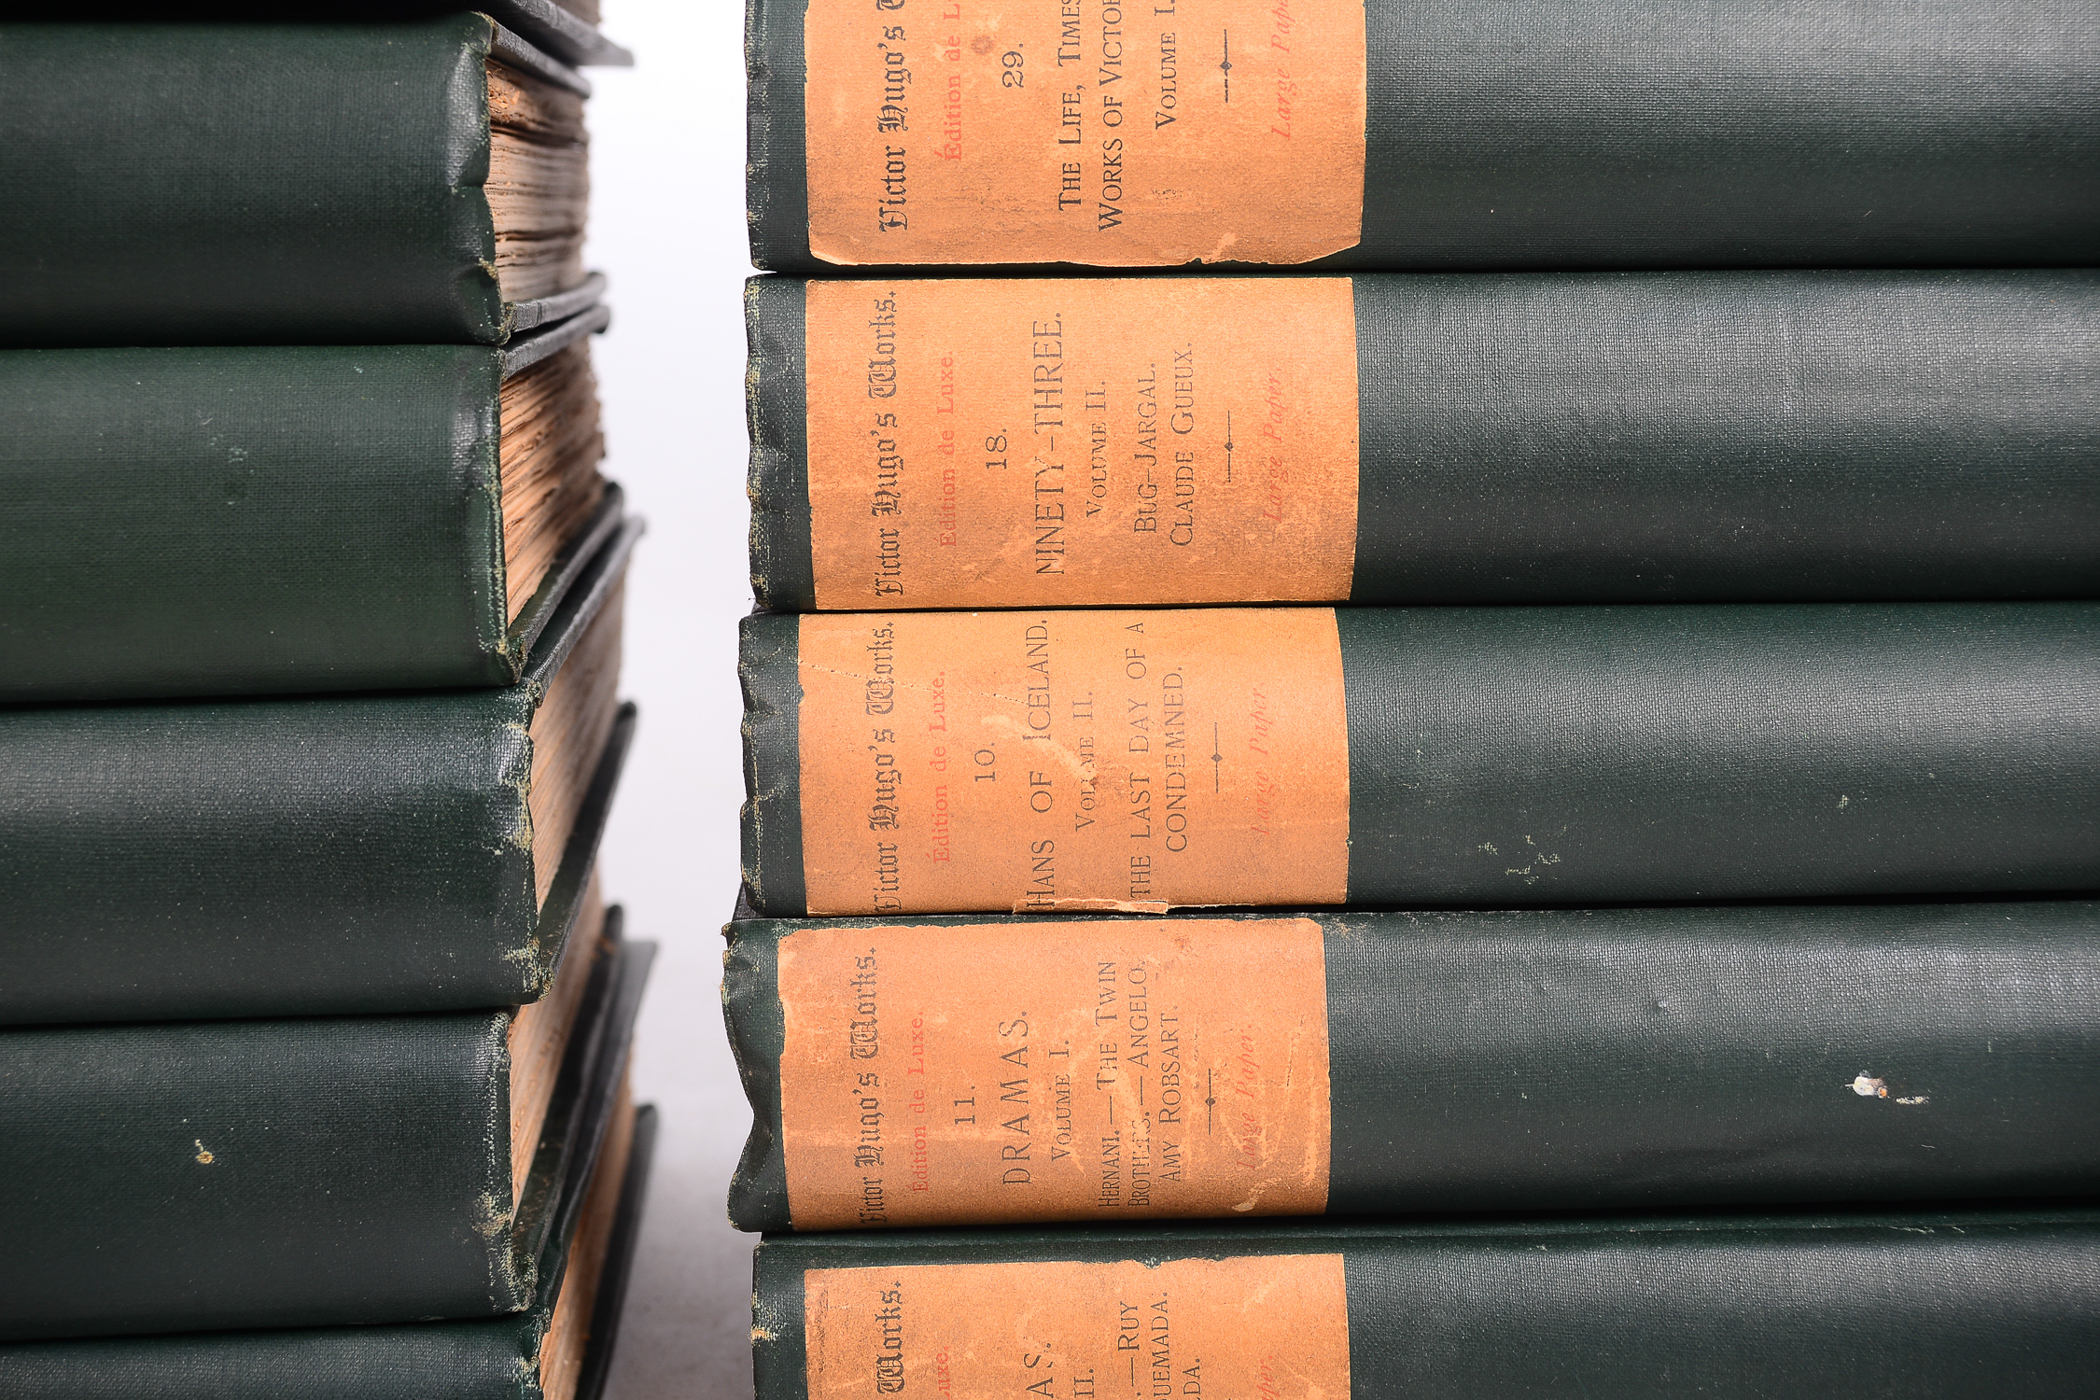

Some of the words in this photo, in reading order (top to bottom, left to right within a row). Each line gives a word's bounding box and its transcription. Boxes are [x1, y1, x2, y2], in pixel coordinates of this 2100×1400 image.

[876, 25, 911, 134] Hugo's
[943, 35, 962, 62] de
[1001, 43, 1024, 88] 29.
[1155, 32, 1177, 130] VOLUME
[934, 74, 962, 161] Édition
[1058, 84, 1086, 145] LIFE,
[1102, 95, 1123, 127] OF
[1271, 68, 1297, 140] Large
[878, 145, 908, 232] Victor
[1058, 162, 1081, 212] THE
[1098, 138, 1123, 231] WORKS
[868, 291, 897, 399] Works.
[936, 350, 954, 415] Luxe.
[1085, 381, 1106, 412] II.
[1170, 342, 1194, 435] GUEUX.
[870, 412, 904, 517] Hugo's
[938, 429, 955, 456] de
[985, 428, 1007, 470] 18.
[1086, 423, 1107, 518] VOLUME
[933, 468, 957, 547] Édition
[1170, 451, 1194, 546] CLAUDE
[1262, 455, 1289, 522] Large
[874, 527, 903, 597] Victor
[1125, 622, 1144, 634] A
[866, 622, 895, 716] Works.
[1022, 620, 1052, 741] ICELAND.
[1125, 648, 1147, 680] OF
[929, 671, 947, 732] Luxe.
[1072, 692, 1093, 721] II.
[1128, 698, 1149, 753] DAY
[868, 729, 902, 832] Hugo's
[929, 745, 947, 772] de
[974, 742, 996, 782] 10.
[1029, 771, 1053, 814] OF
[1075, 736, 1097, 832] VOLME
[1163, 667, 1188, 852] CONDEMNED.
[926, 784, 951, 863] Édition
[1129, 772, 1151, 839] LAST
[874, 842, 902, 913] Victor
[1026, 839, 1055, 908] HANS
[1130, 855, 1151, 898] THE
[850, 947, 879, 1060] Works.
[1095, 961, 1118, 1027] TWIN
[907, 1011, 925, 1075] Luxe.
[1048, 1040, 1070, 1058] I.
[1159, 1005, 1182, 1125] ROBSART.
[852, 1072, 884, 1168] Hugo's
[909, 1089, 925, 1114] de
[954, 1085, 976, 1125] 11.
[999, 1011, 1031, 1185] DRAMAS.
[1052, 1074, 1072, 1162] VOLUME
[906, 1126, 929, 1192] Édition
[1159, 1140, 1181, 1183] AMY
[859, 1176, 887, 1224] Victor
[875, 1280, 905, 1394] Works.
[1151, 1292, 1173, 1400] UEMADA.
